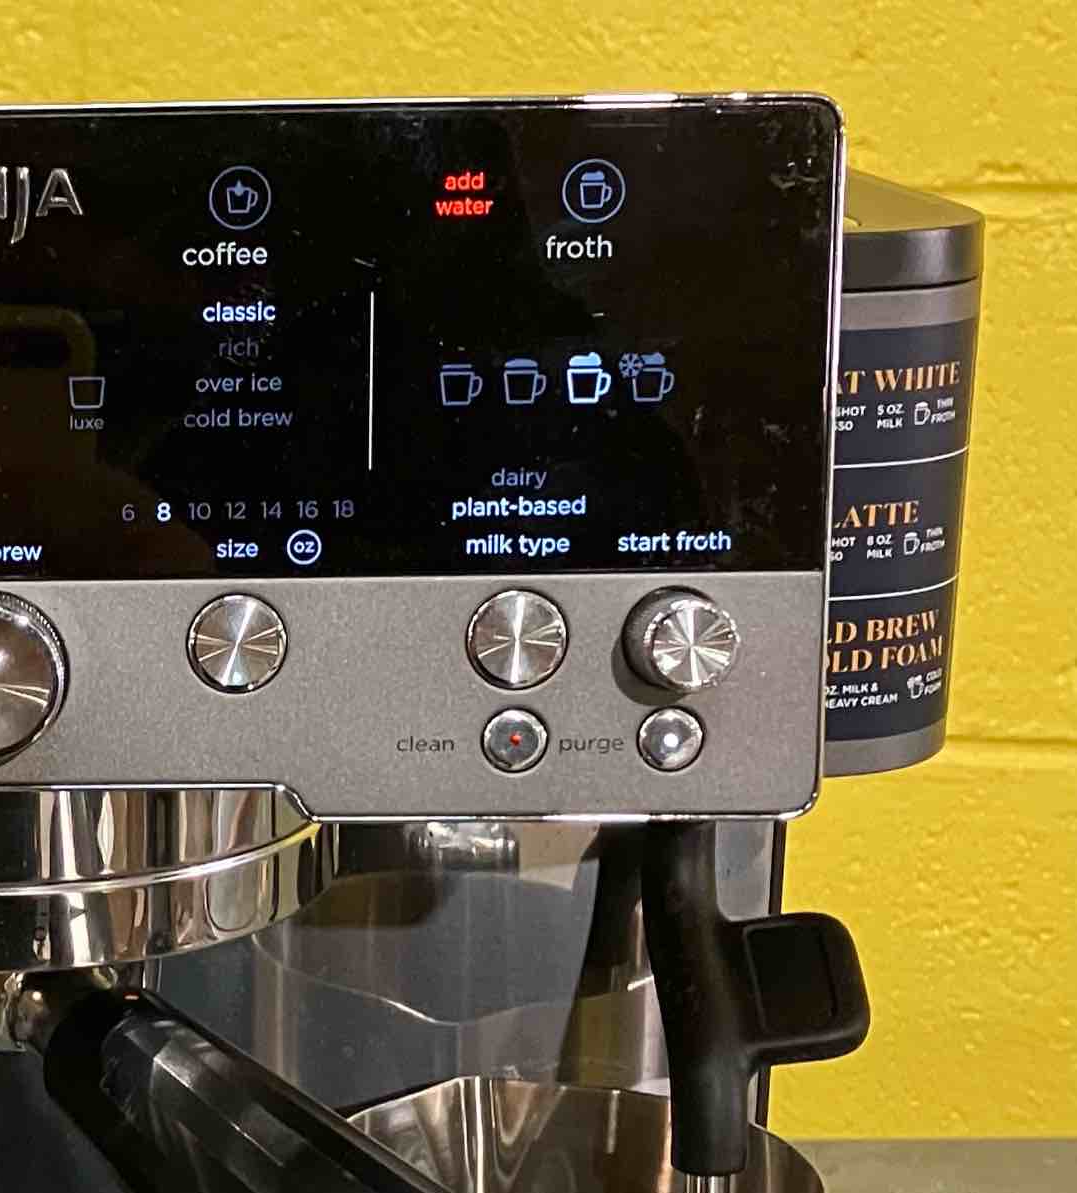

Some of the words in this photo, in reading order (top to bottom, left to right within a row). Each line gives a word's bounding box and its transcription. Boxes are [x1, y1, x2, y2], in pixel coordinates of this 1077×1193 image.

[445, 172, 484, 190] add
[436, 198, 493, 216] water
[183, 242, 267, 265] coffee
[546, 235, 612, 258] froth
[203, 301, 275, 322] classic
[219, 337, 258, 358] rich
[196, 376, 243, 392] over
[252, 373, 282, 391] ice
[874, 361, 961, 392] WHITE
[70, 416, 103, 429] luxe
[184, 408, 230, 427] cold
[239, 409, 292, 426] brew
[876, 418, 903, 430] MILK
[492, 468, 546, 489] dairy
[122, 504, 134, 521] 6
[157, 503, 171, 521] 8
[189, 503, 211, 520] 10
[227, 502, 245, 519] 12
[262, 502, 282, 518] 14
[297, 501, 318, 518] 16
[333, 500, 354, 518] 18
[452, 495, 586, 520] plant-based
[834, 501, 919, 529] ATTE
[217, 539, 258, 558] size
[293, 541, 316, 554] oz
[466, 534, 512, 554] milk
[519, 535, 570, 556] type
[618, 533, 670, 552] start
[676, 531, 731, 551] froth
[866, 548, 893, 560] MILK
[827, 621, 858, 645] D
[866, 608, 940, 642] BREW
[881, 635, 943, 670] FOAM
[842, 682, 869, 695] MILK
[860, 692, 899, 707] CREAM
[395, 735, 456, 753] clean
[558, 736, 625, 755] purge
